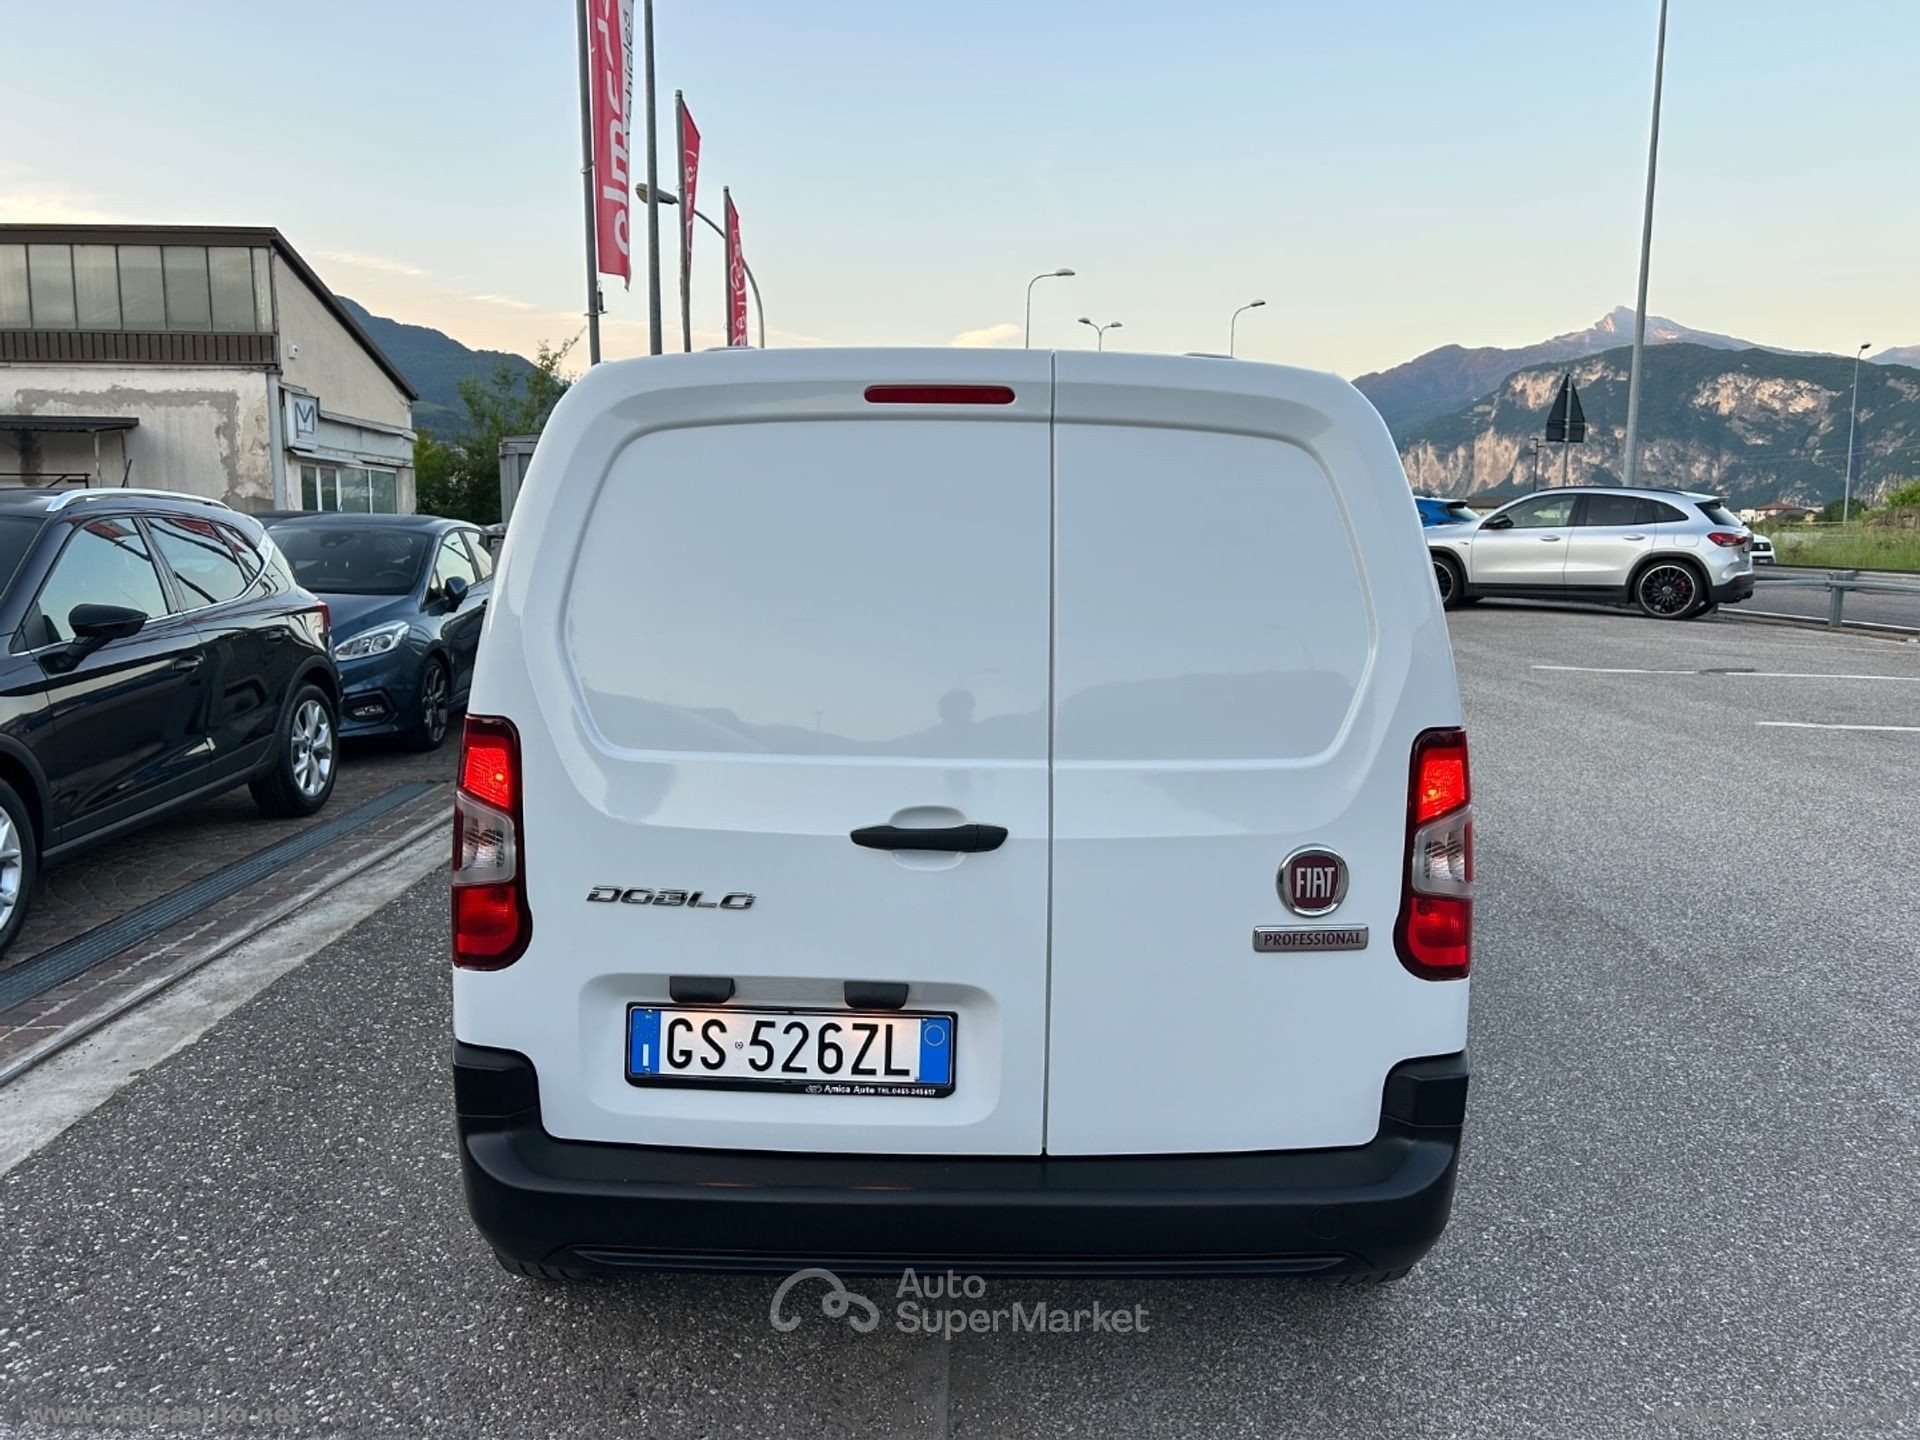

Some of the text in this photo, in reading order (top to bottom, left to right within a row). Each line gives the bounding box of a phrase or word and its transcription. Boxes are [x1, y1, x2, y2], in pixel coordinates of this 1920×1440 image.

[1296, 867, 1336, 899] FIAT
[1263, 931, 1361, 947] PROFESSIONAL
[666, 1017, 911, 1077] GS 526ZL
[824, 1084, 851, 1094] Amica
[853, 1085, 876, 1095] Auto
